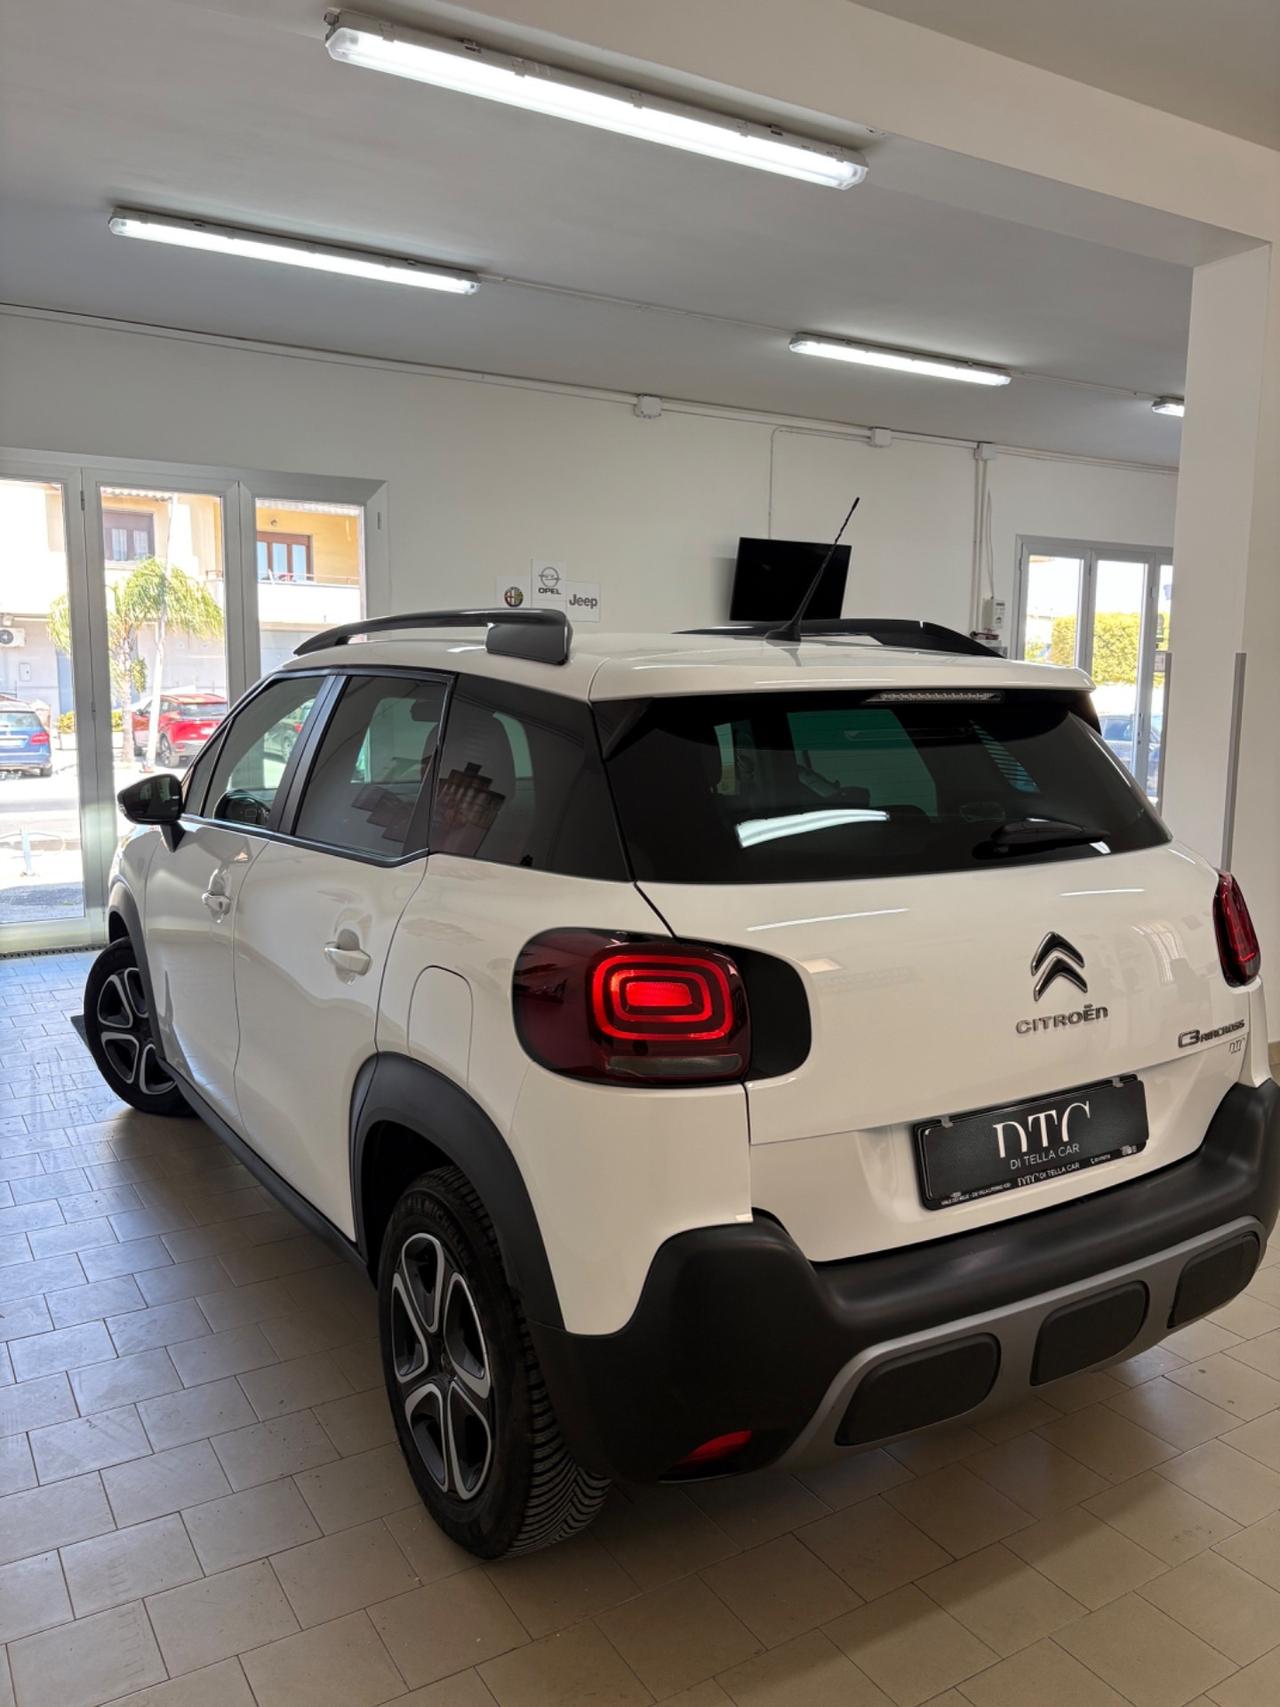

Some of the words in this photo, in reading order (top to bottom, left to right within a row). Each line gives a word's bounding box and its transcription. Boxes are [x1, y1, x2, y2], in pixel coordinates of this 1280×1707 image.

[538, 587, 561, 595] OPEL
[569, 594, 598, 609] Jeep
[993, 1100, 1091, 1158] DTC
[1010, 1157, 1022, 1170] DI
[1023, 1150, 1057, 1168] TELLA
[1058, 1143, 1080, 1157] CAR
[1048, 1166, 1067, 1178] TELLA
[1067, 1162, 1080, 1173] CAR
